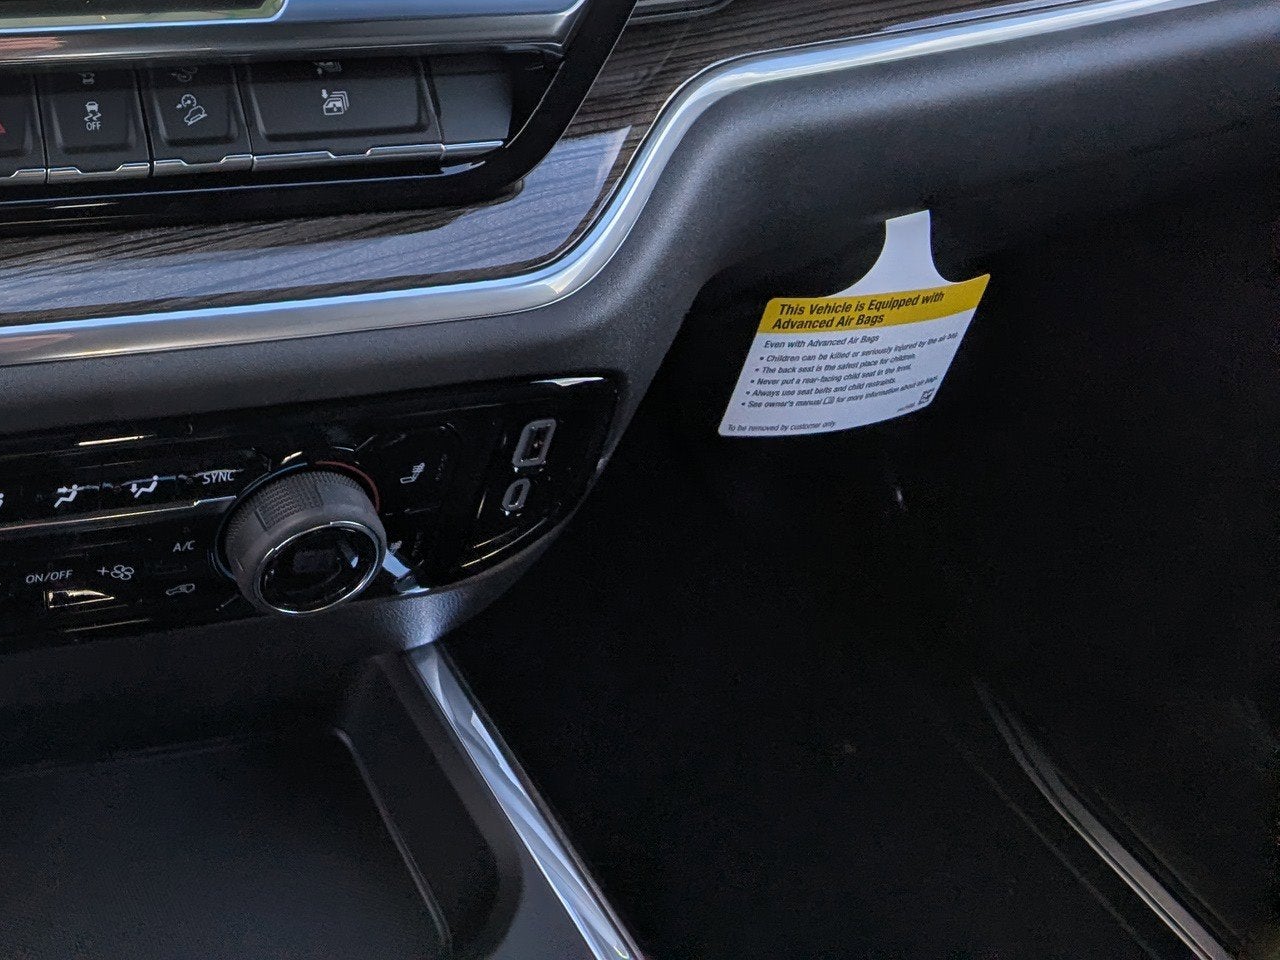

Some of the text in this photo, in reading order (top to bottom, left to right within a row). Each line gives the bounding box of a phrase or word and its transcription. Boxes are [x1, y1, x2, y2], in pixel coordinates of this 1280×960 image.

[86, 121, 102, 131] OFF
[779, 291, 945, 315] This Vehicle is Equipped with
[772, 313, 884, 330] Advanced Air Bags
[764, 334, 880, 349] Even with Advanced Air Bags
[766, 354, 800, 362] Children
[762, 366, 776, 374] The
[797, 365, 815, 373] seat
[824, 364, 836, 372] the
[859, 360, 878, 369] place
[780, 377, 794, 386] put
[843, 372, 861, 380] child
[861, 370, 876, 379] seat
[751, 389, 780, 397] Always
[796, 388, 813, 396] seat
[847, 382, 865, 391] child
[747, 400, 763, 408] See
[728, 424, 739, 432] To
[790, 421, 821, 431] customer
[202, 470, 235, 485] SYNC
[173, 541, 196, 552] A/C
[26, 570, 74, 584] ON/OFF
